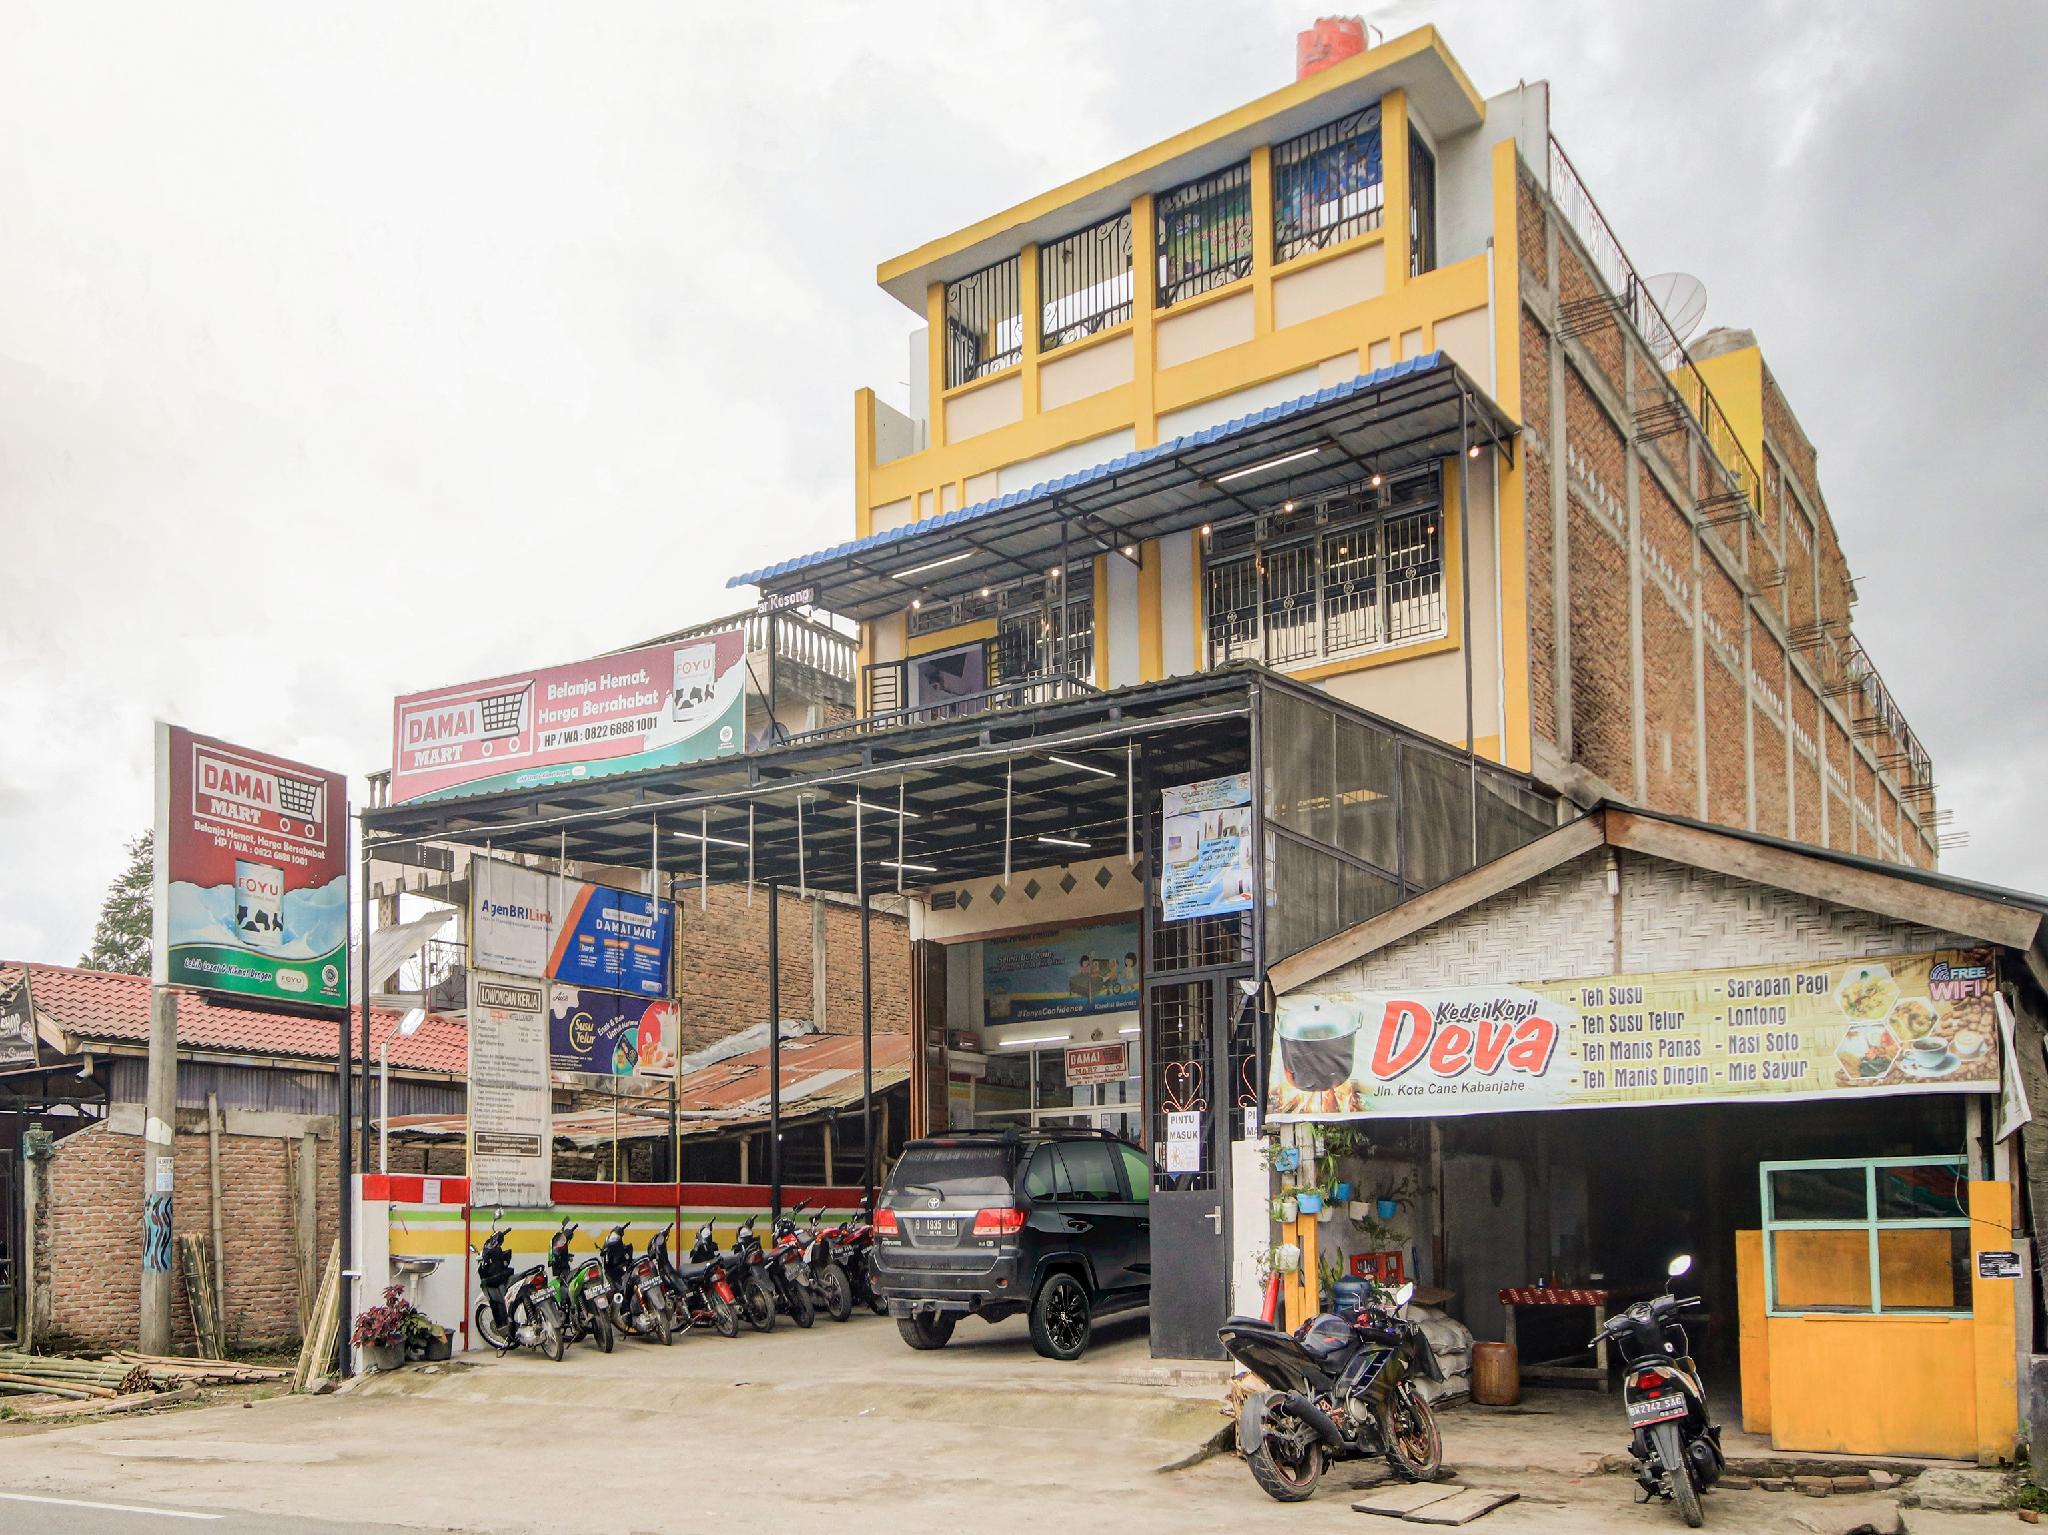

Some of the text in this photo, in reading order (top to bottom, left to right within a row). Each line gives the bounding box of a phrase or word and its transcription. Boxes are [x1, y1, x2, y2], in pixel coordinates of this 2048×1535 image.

[677, 658, 711, 674] FOYU
[547, 668, 650, 700] Belanja Hemat,
[538, 689, 659, 725] Harga Bersahabat
[409, 708, 475, 745] DAMAI
[544, 734, 557, 746] HP
[564, 730, 579, 744] WA
[584, 724, 608, 741] 0822
[610, 720, 634, 737] 6888
[637, 717, 657, 731] 1001
[414, 745, 464, 767] MART
[204, 763, 272, 804] DAMAI
[211, 798, 261, 824] MART
[194, 820, 226, 837] Belanja
[258, 834, 282, 850] Harga
[283, 841, 326, 860] Bersahabat
[214, 837, 228, 847] HP
[234, 841, 248, 852] WA
[292, 854, 308, 866] 1001
[238, 877, 280, 896] FOYU
[596, 918, 631, 935] DAMAI
[633, 926, 657, 940] MART
[1950, 966, 1987, 980] FREE
[1727, 972, 1829, 998] Sarapan Pagi
[1930, 979, 1982, 1001] WIFI
[481, 986, 538, 1008] LOWONGAN KERJA
[1581, 986, 1643, 1007] Teh Susu
[575, 1018, 594, 1032] Susu
[1581, 1011, 1685, 1034] Teh Susu Telur
[1728, 1005, 1786, 1027] Lontong
[576, 1031, 597, 1046] Telur
[1371, 1000, 1559, 1082] Deva
[1728, 1032, 1799, 1054] Nasi Soto
[1070, 1051, 1100, 1066] DAMAI
[1582, 1038, 1701, 1062] Teh Manis Panas
[1582, 1065, 1709, 1089] Teh Manis Dingin
[1728, 1060, 1808, 1081] Mie Sayur
[1373, 1080, 1525, 1097] Jln. Kota Cane Kabanjahe
[1170, 1115, 1195, 1125] PINTU
[1169, 1130, 1198, 1140] MASUK
[926, 1219, 942, 1230] 1935
[947, 1219, 956, 1230] LB
